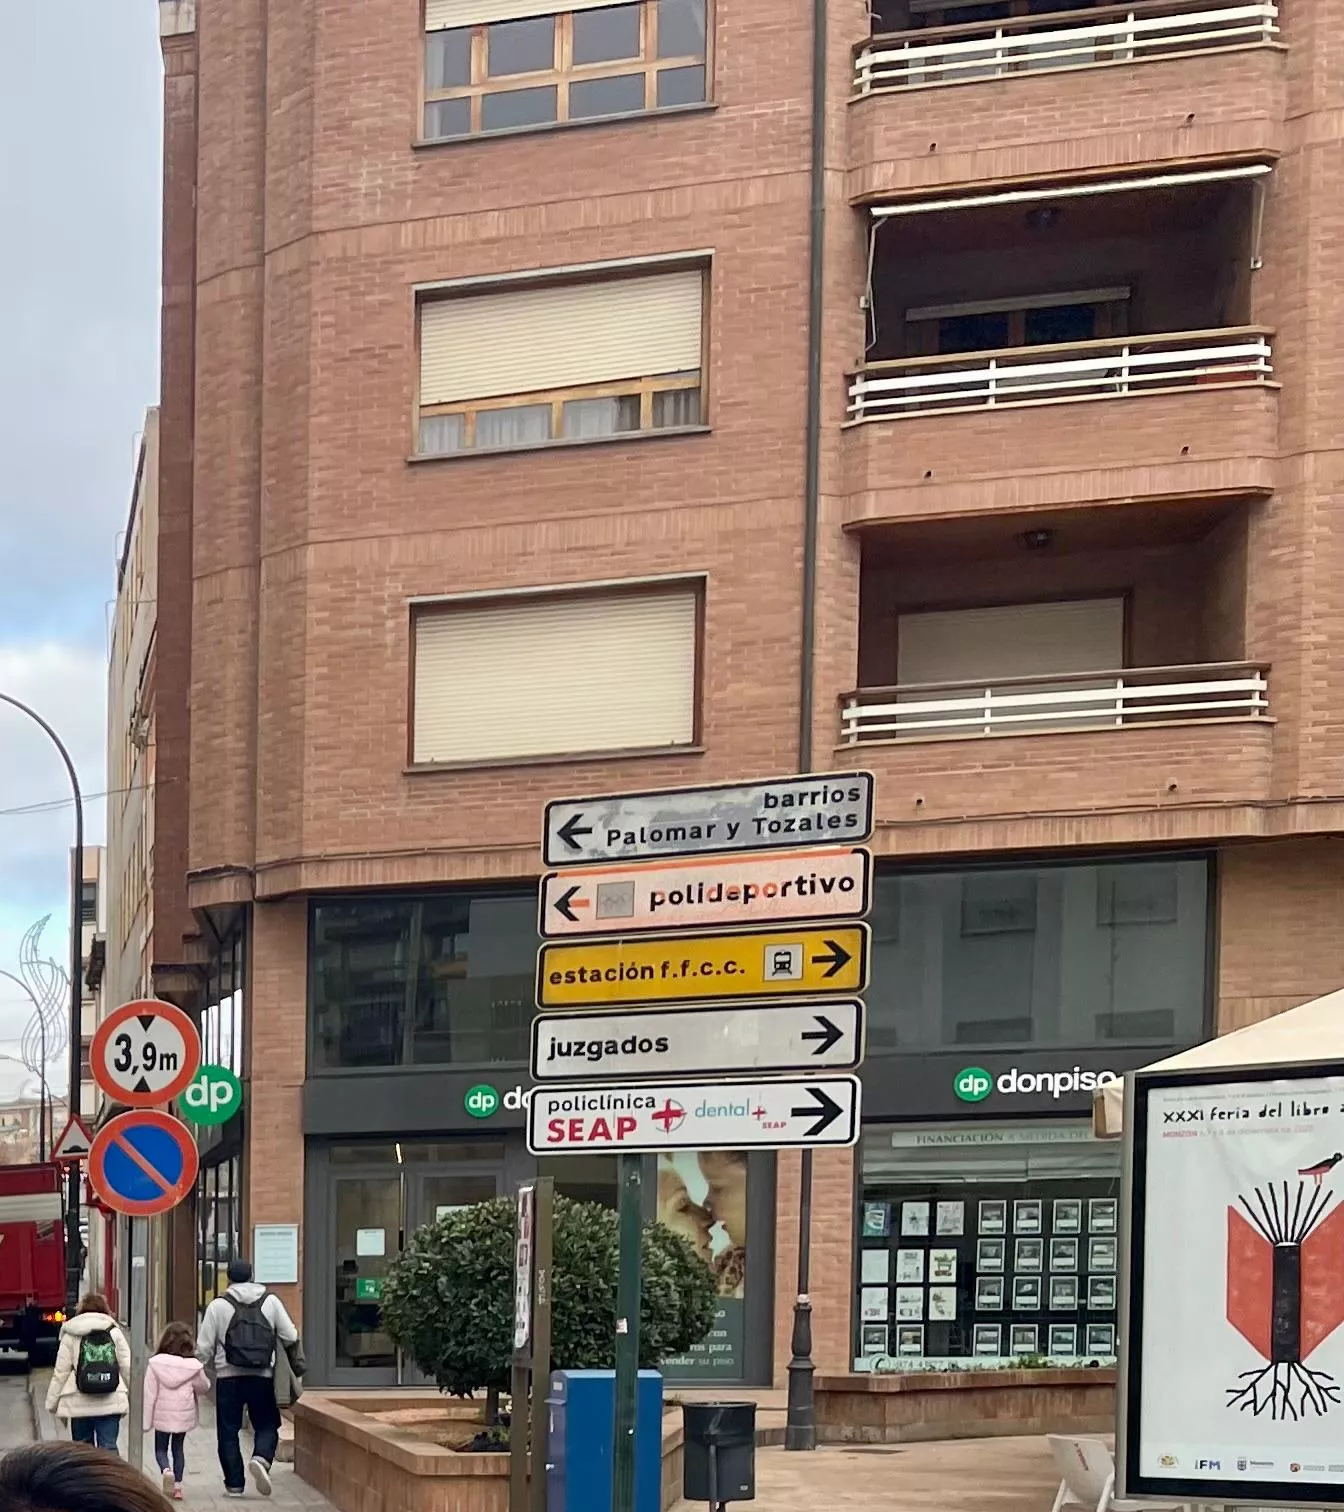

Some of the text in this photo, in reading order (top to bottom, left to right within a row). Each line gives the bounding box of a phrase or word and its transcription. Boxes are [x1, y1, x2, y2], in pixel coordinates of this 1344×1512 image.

[763, 785, 861, 809] barrios
[607, 812, 858, 846] Palomar y Tozales
[649, 872, 855, 911] polideportivo
[549, 958, 745, 986] estación f.f.c.c.
[547, 1035, 669, 1062] juzgados
[185, 1075, 234, 1112] dp
[959, 1066, 1116, 1099] dp donpiso
[468, 1091, 495, 1112] dp
[547, 1093, 656, 1115] policlínica
[694, 1098, 750, 1119] dental
[1163, 1110, 1205, 1124] XXXI
[1210, 1106, 1250, 1121] feria
[1259, 1102, 1283, 1118] del
[1291, 1100, 1330, 1117] libro
[546, 1116, 638, 1143] SEAP
[916, 1132, 1004, 1145] FINANCIACIÓN
